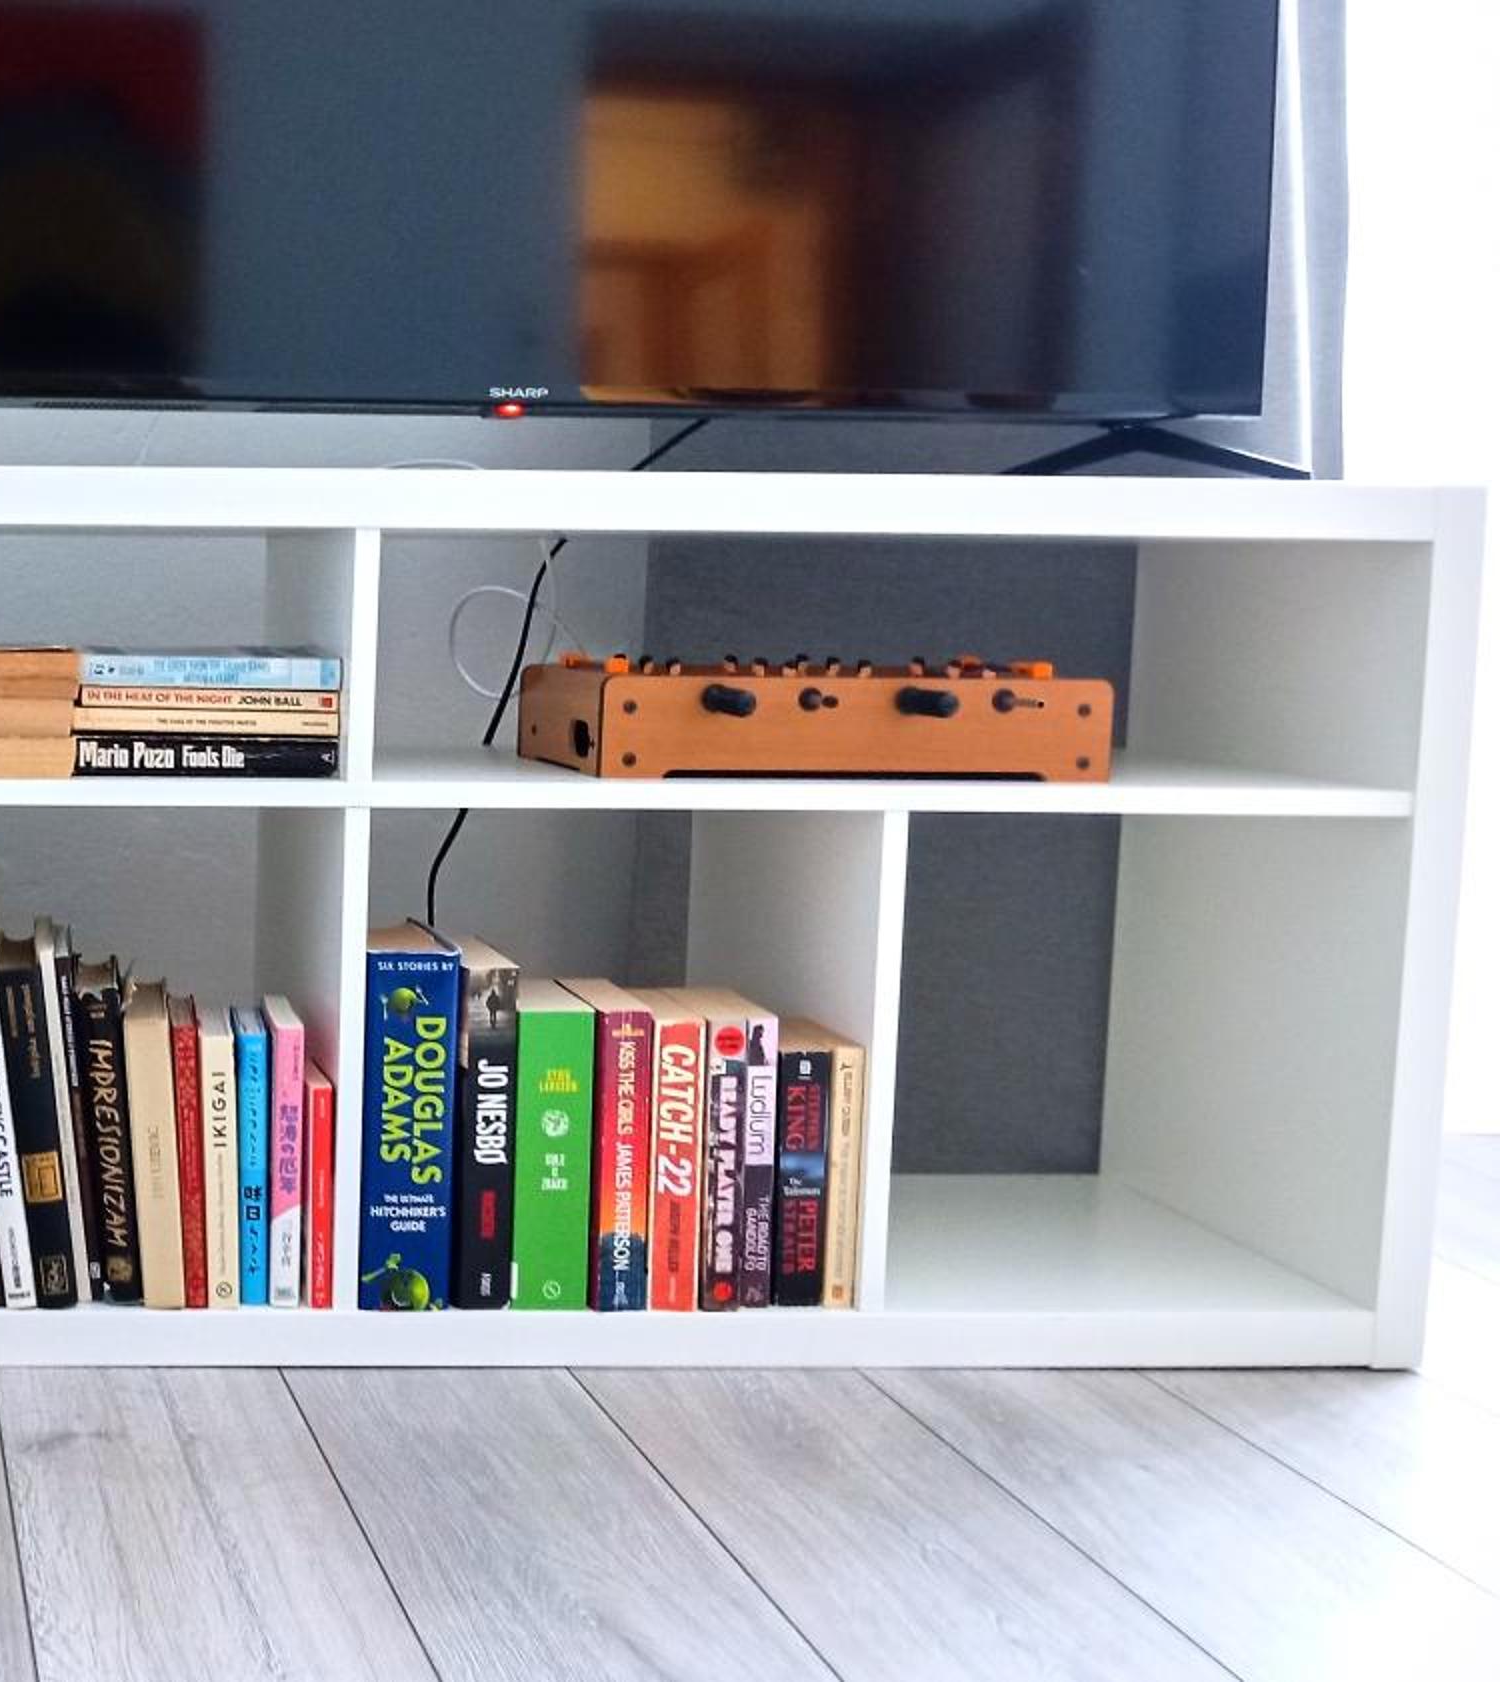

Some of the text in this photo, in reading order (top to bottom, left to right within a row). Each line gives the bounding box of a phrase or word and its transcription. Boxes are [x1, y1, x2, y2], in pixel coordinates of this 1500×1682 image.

[489, 387, 548, 398] SHARP
[87, 691, 232, 704] IN THE HEAT OF THE NIGHT
[237, 695, 302, 707] JOHN BALL
[79, 741, 245, 769] Mario Puzo Fools Die
[377, 962, 454, 971] SIX STORIES BY
[618, 1041, 636, 1070] KISS
[477, 1058, 509, 1089] JO
[617, 1072, 636, 1096] THE
[211, 1072, 227, 1147] IKIGAI
[380, 1036, 414, 1163] ADAMS
[411, 1016, 447, 1185] DOUGLAS
[748, 1075, 773, 1155] Ludlum
[473, 1094, 508, 1165] NESBØ
[617, 1100, 635, 1135] GIRLS
[657, 1043, 696, 1196] CATCH-22
[787, 1085, 807, 1149] KING
[90, 1039, 128, 1247] IMPRESIONIZAM
[615, 1141, 633, 1189] JAMES
[715, 1076, 738, 1273] READY PLAYER ONE
[789, 1177, 803, 1186] The
[369, 1206, 447, 1218] HITCHHIKER'S
[383, 1194, 434, 1203] THE ULTIMATE
[759, 1196, 771, 1221] THE
[389, 1220, 427, 1232] GUIDE
[612, 1192, 632, 1271] PATTERSON
[757, 1222, 771, 1254] ROAD
[798, 1198, 818, 1271] PETER
